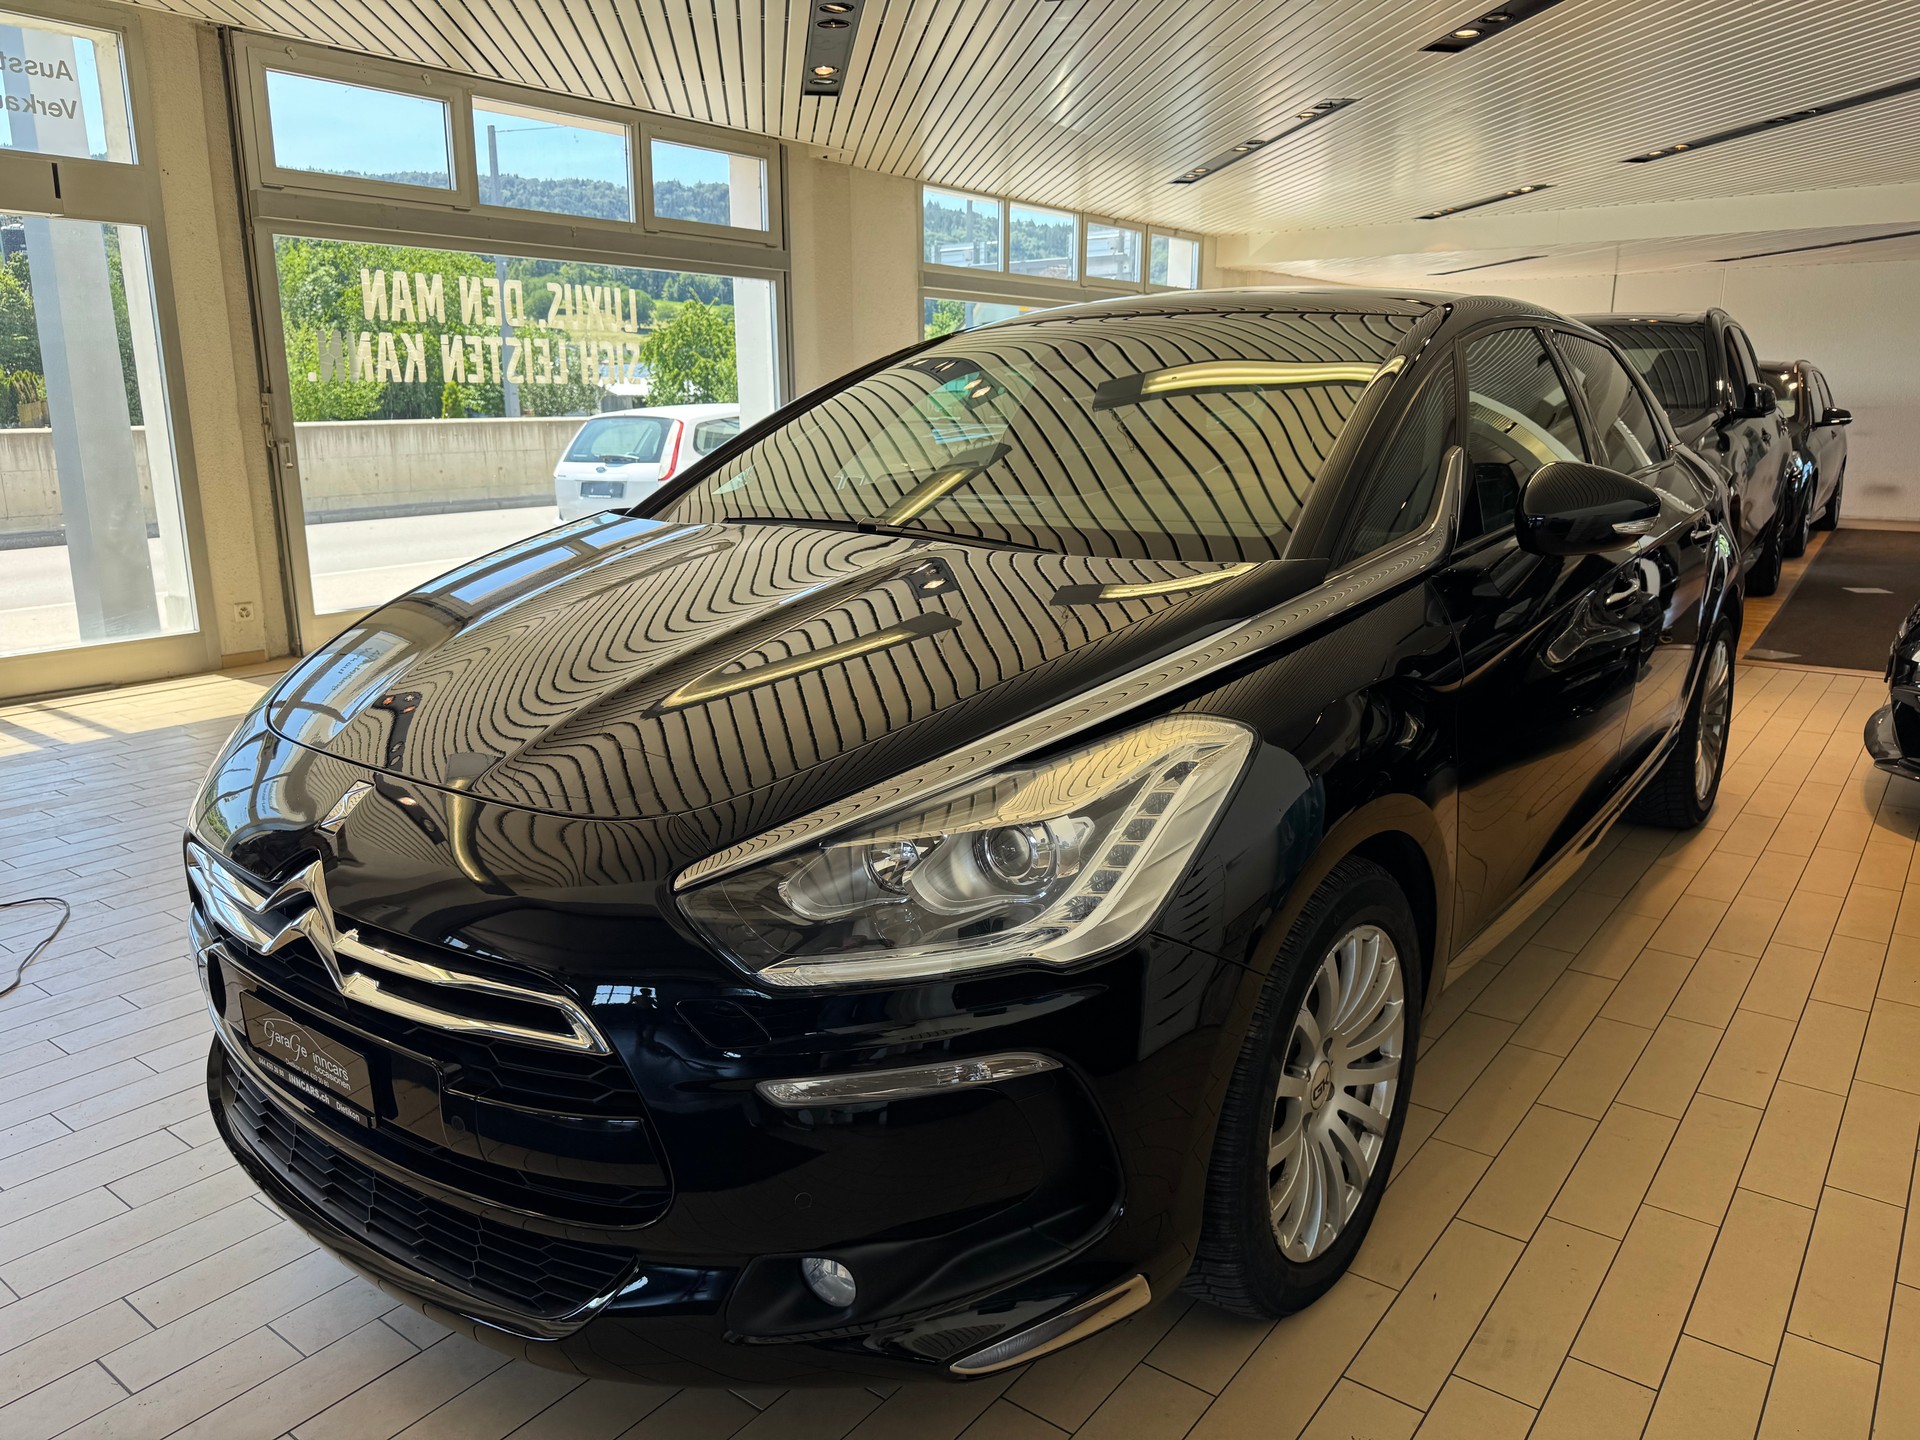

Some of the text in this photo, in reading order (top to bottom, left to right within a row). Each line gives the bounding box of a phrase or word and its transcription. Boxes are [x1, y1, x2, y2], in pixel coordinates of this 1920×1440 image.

[312, 1052, 349, 1081] inncars
[288, 1073, 330, 1105] INNCARS.ch
[336, 1101, 360, 1122] Dietikon
